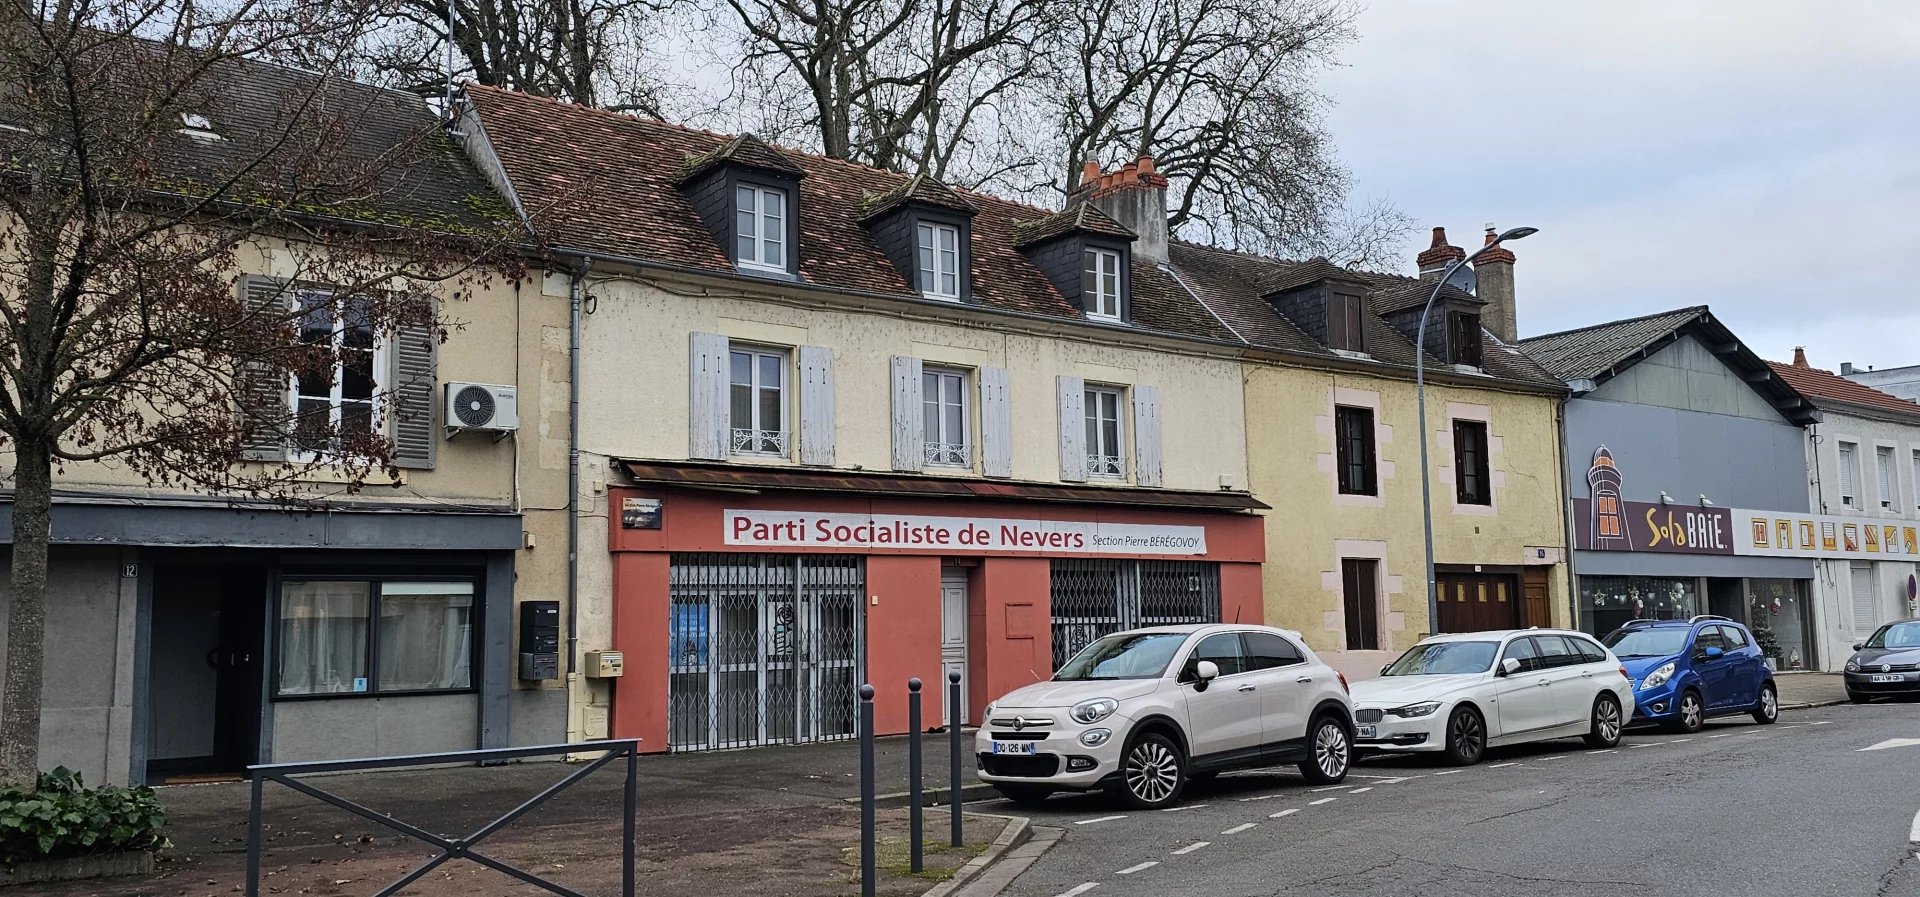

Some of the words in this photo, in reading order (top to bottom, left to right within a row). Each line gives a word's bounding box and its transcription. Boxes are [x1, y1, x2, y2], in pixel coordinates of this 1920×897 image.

[733, 516, 805, 542] Parti
[815, 519, 950, 544] Socialiste
[957, 523, 990, 545] de
[1000, 525, 1084, 548] Nevers
[1092, 534, 1123, 546] Section
[1125, 535, 1148, 547] Pierre
[1149, 535, 1200, 548] BÉRÉGOVOY
[126, 565, 135, 576] 12
